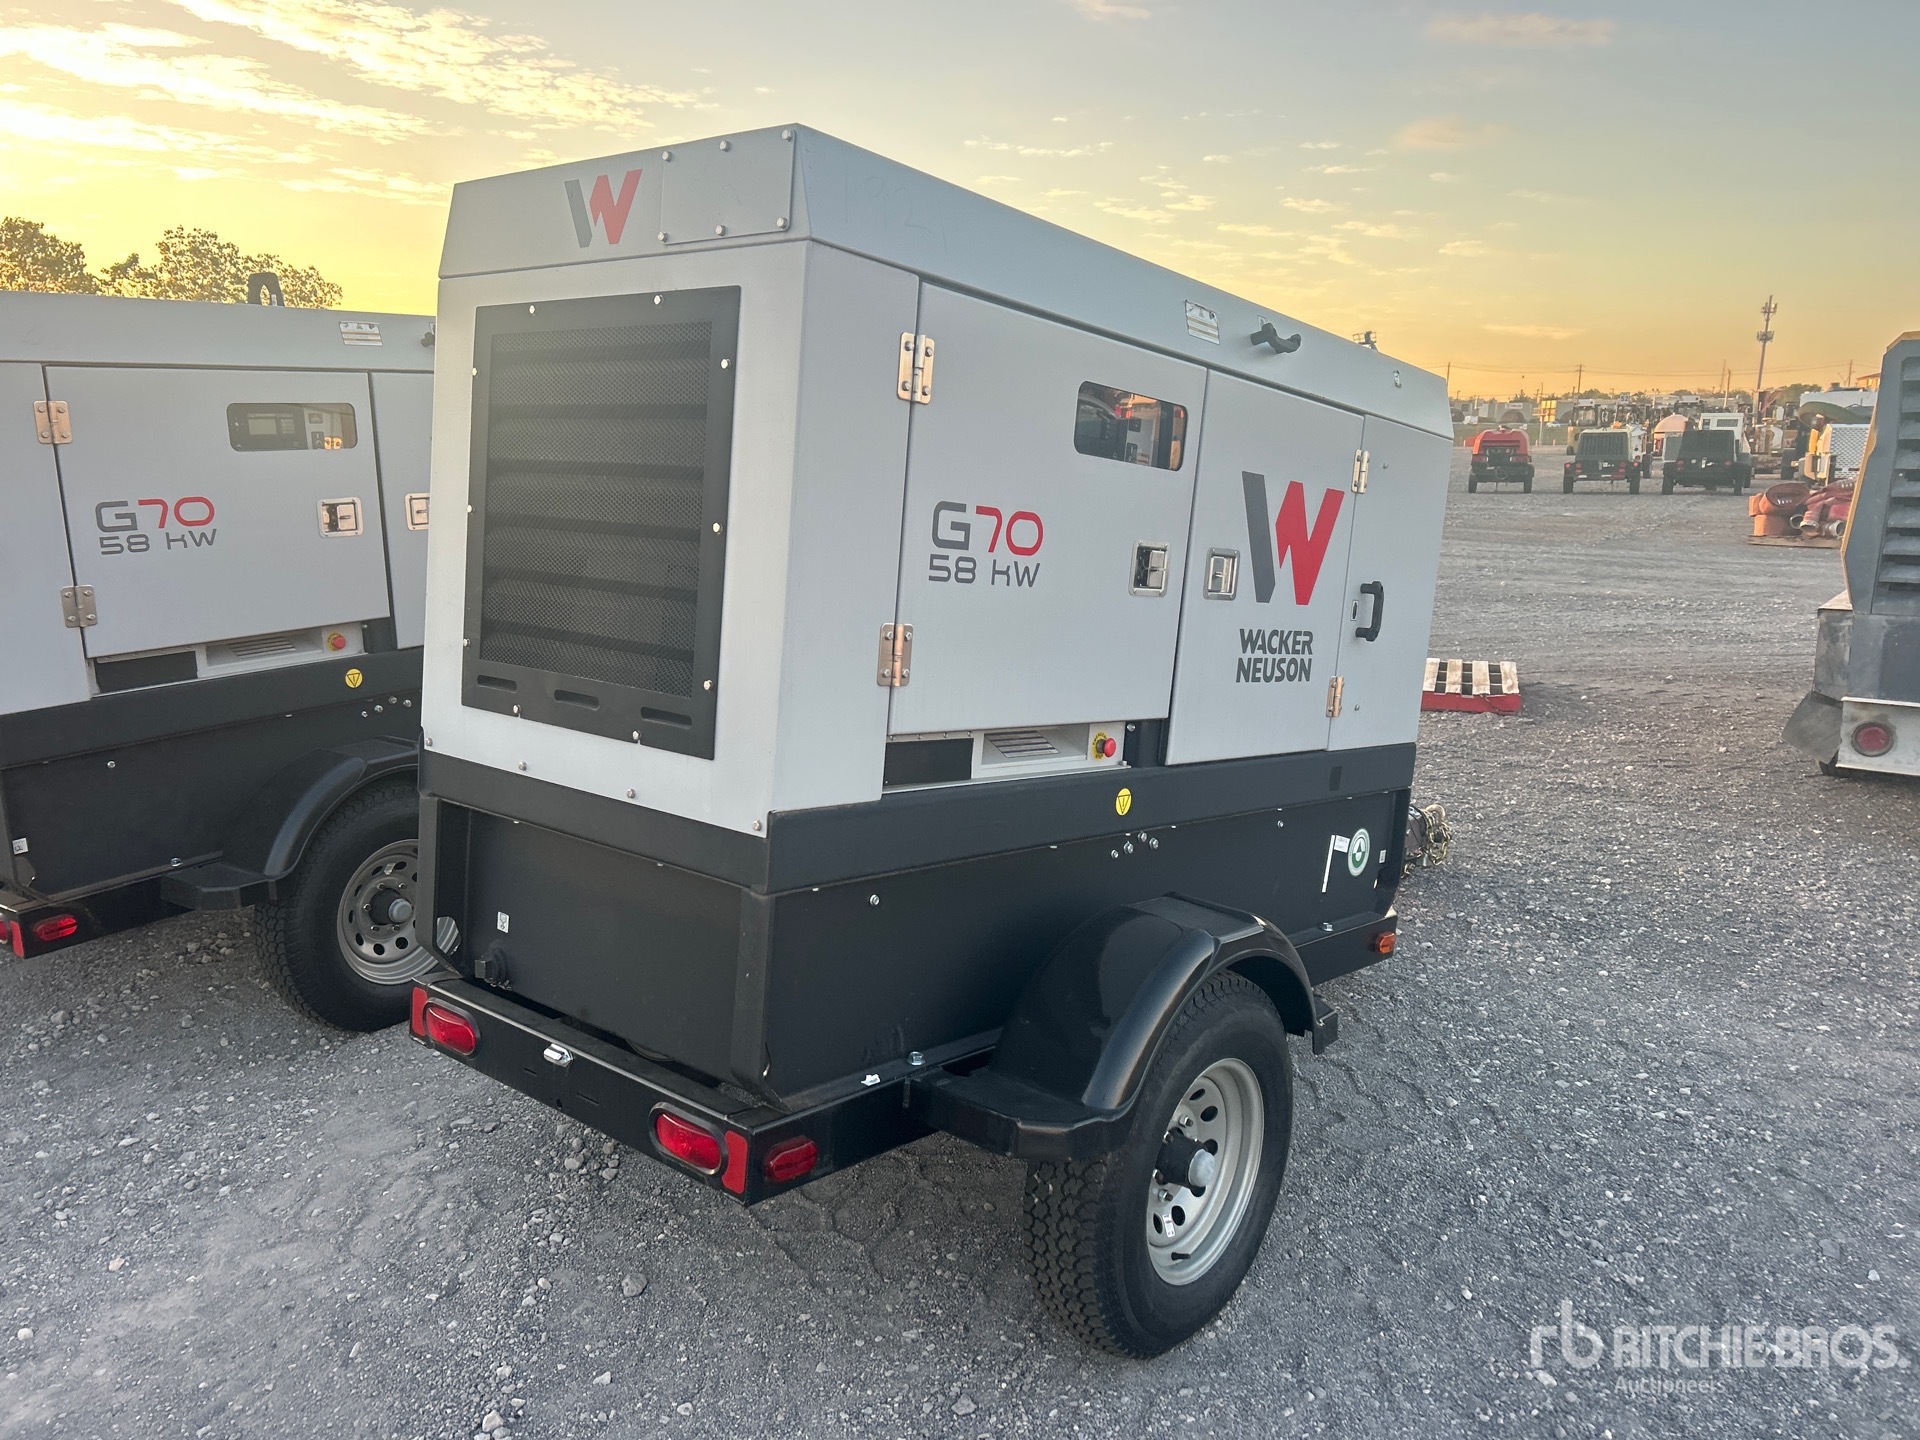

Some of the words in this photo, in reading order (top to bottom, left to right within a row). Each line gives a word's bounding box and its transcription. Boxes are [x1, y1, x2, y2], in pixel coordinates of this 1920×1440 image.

[95, 496, 215, 533] G70
[931, 500, 1044, 557] G70
[99, 533, 150, 555] 58
[928, 553, 977, 584] 58
[1239, 628, 1314, 655] WACKER
[1235, 657, 1312, 683] NEUSON
